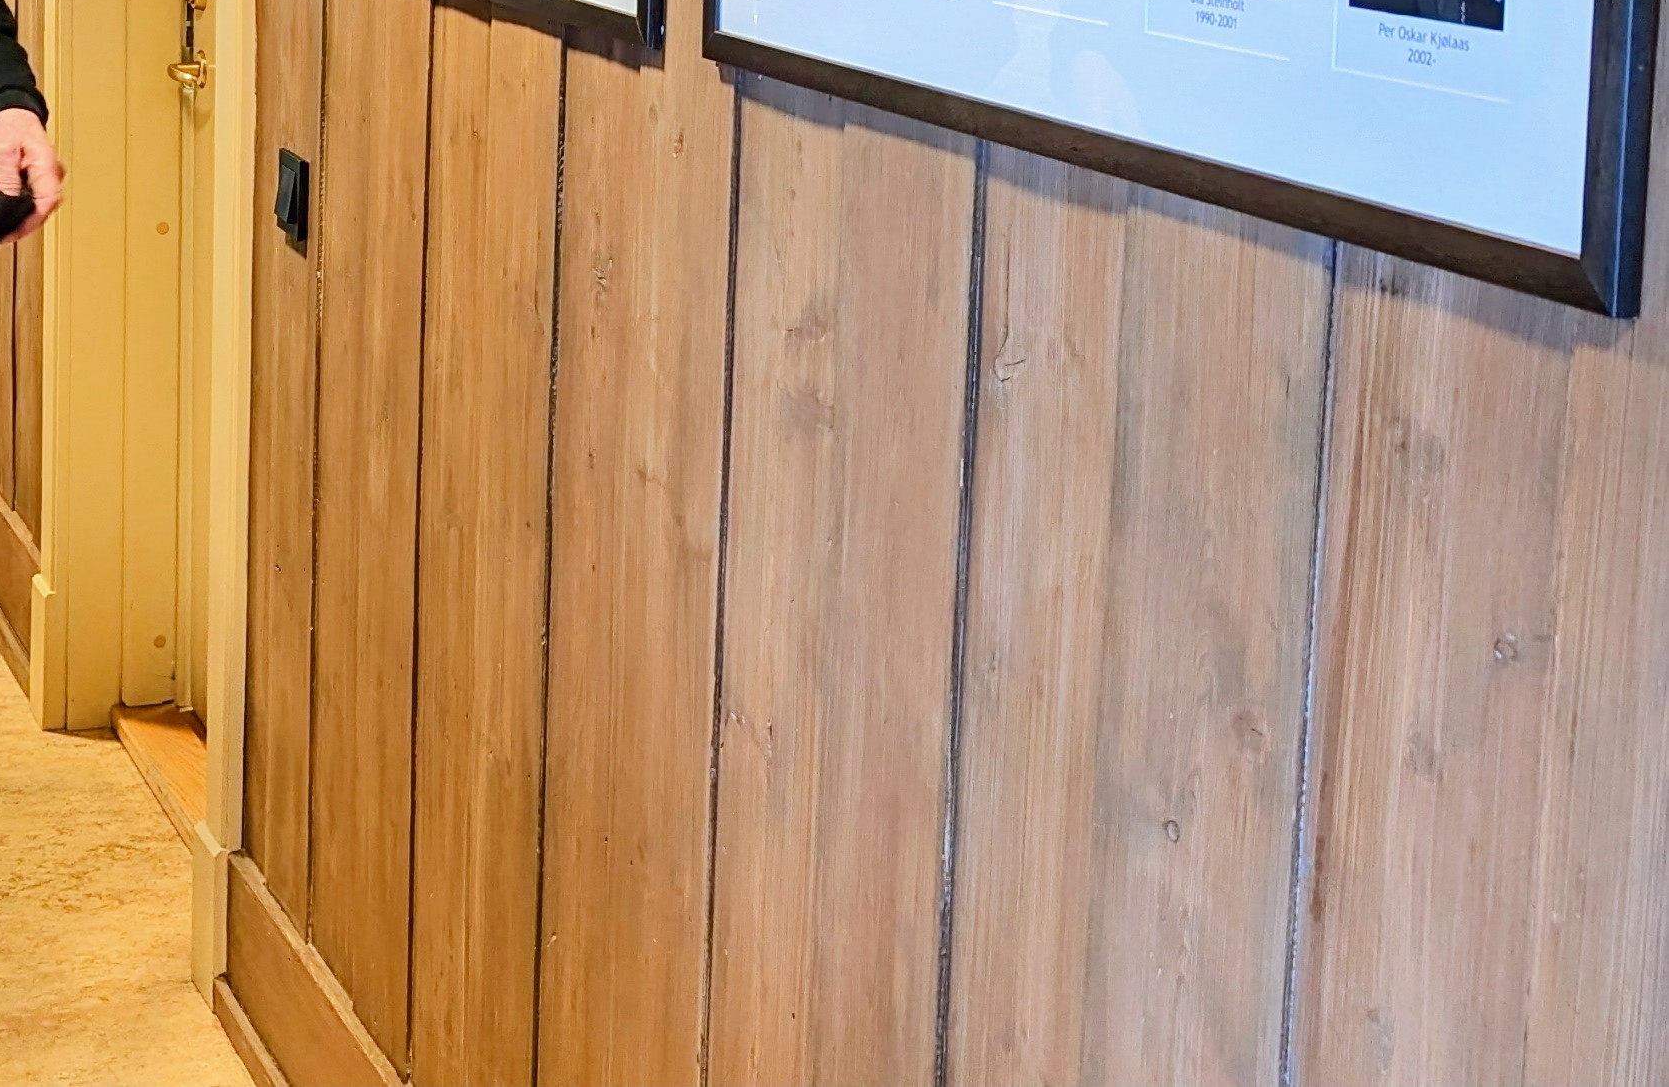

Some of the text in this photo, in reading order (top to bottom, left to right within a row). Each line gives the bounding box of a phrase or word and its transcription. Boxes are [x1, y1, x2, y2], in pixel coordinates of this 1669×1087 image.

[1195, 10, 1238, 30] 1990-2001
[1378, 22, 1395, 38] Per
[1398, 25, 1427, 44] Oskar
